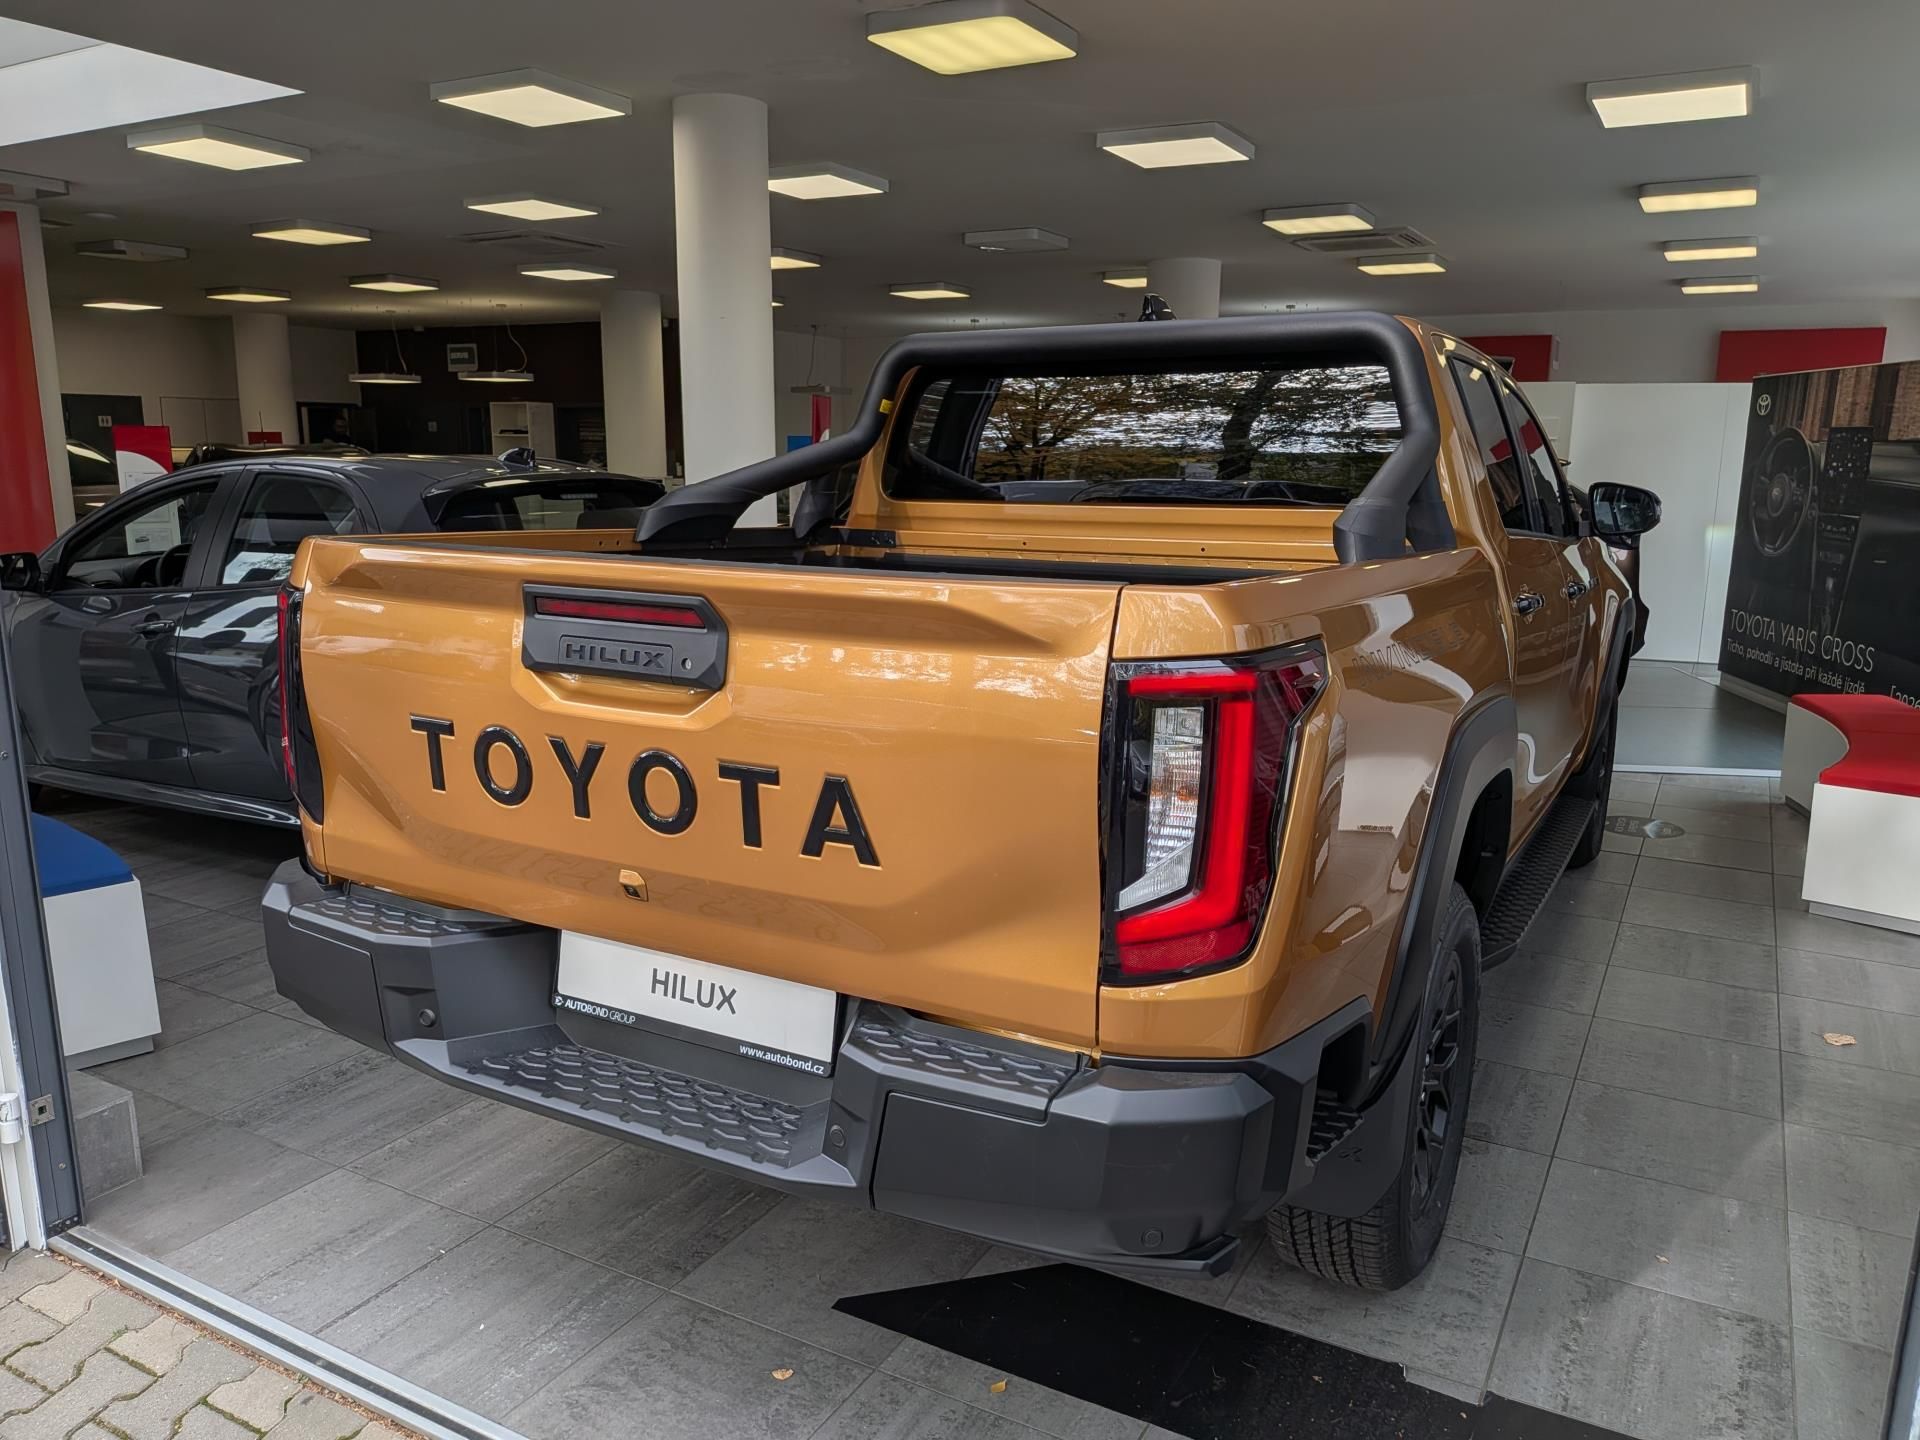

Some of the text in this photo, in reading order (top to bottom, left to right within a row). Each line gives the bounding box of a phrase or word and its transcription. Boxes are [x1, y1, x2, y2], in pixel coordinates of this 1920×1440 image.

[565, 643, 665, 669] HILUX
[1731, 608, 1875, 673] TOYOTA YARIS CROSS
[1773, 656, 1779, 668] a
[1779, 657, 1803, 676] jistota
[1804, 664, 1817, 681] při
[1817, 667, 1843, 689] každé
[410, 713, 882, 868] TOYOTA
[651, 967, 737, 1015] HILUX
[565, 999, 636, 1025] AUTOBOND GROUP
[739, 1044, 824, 1075] www.autobond.cz
